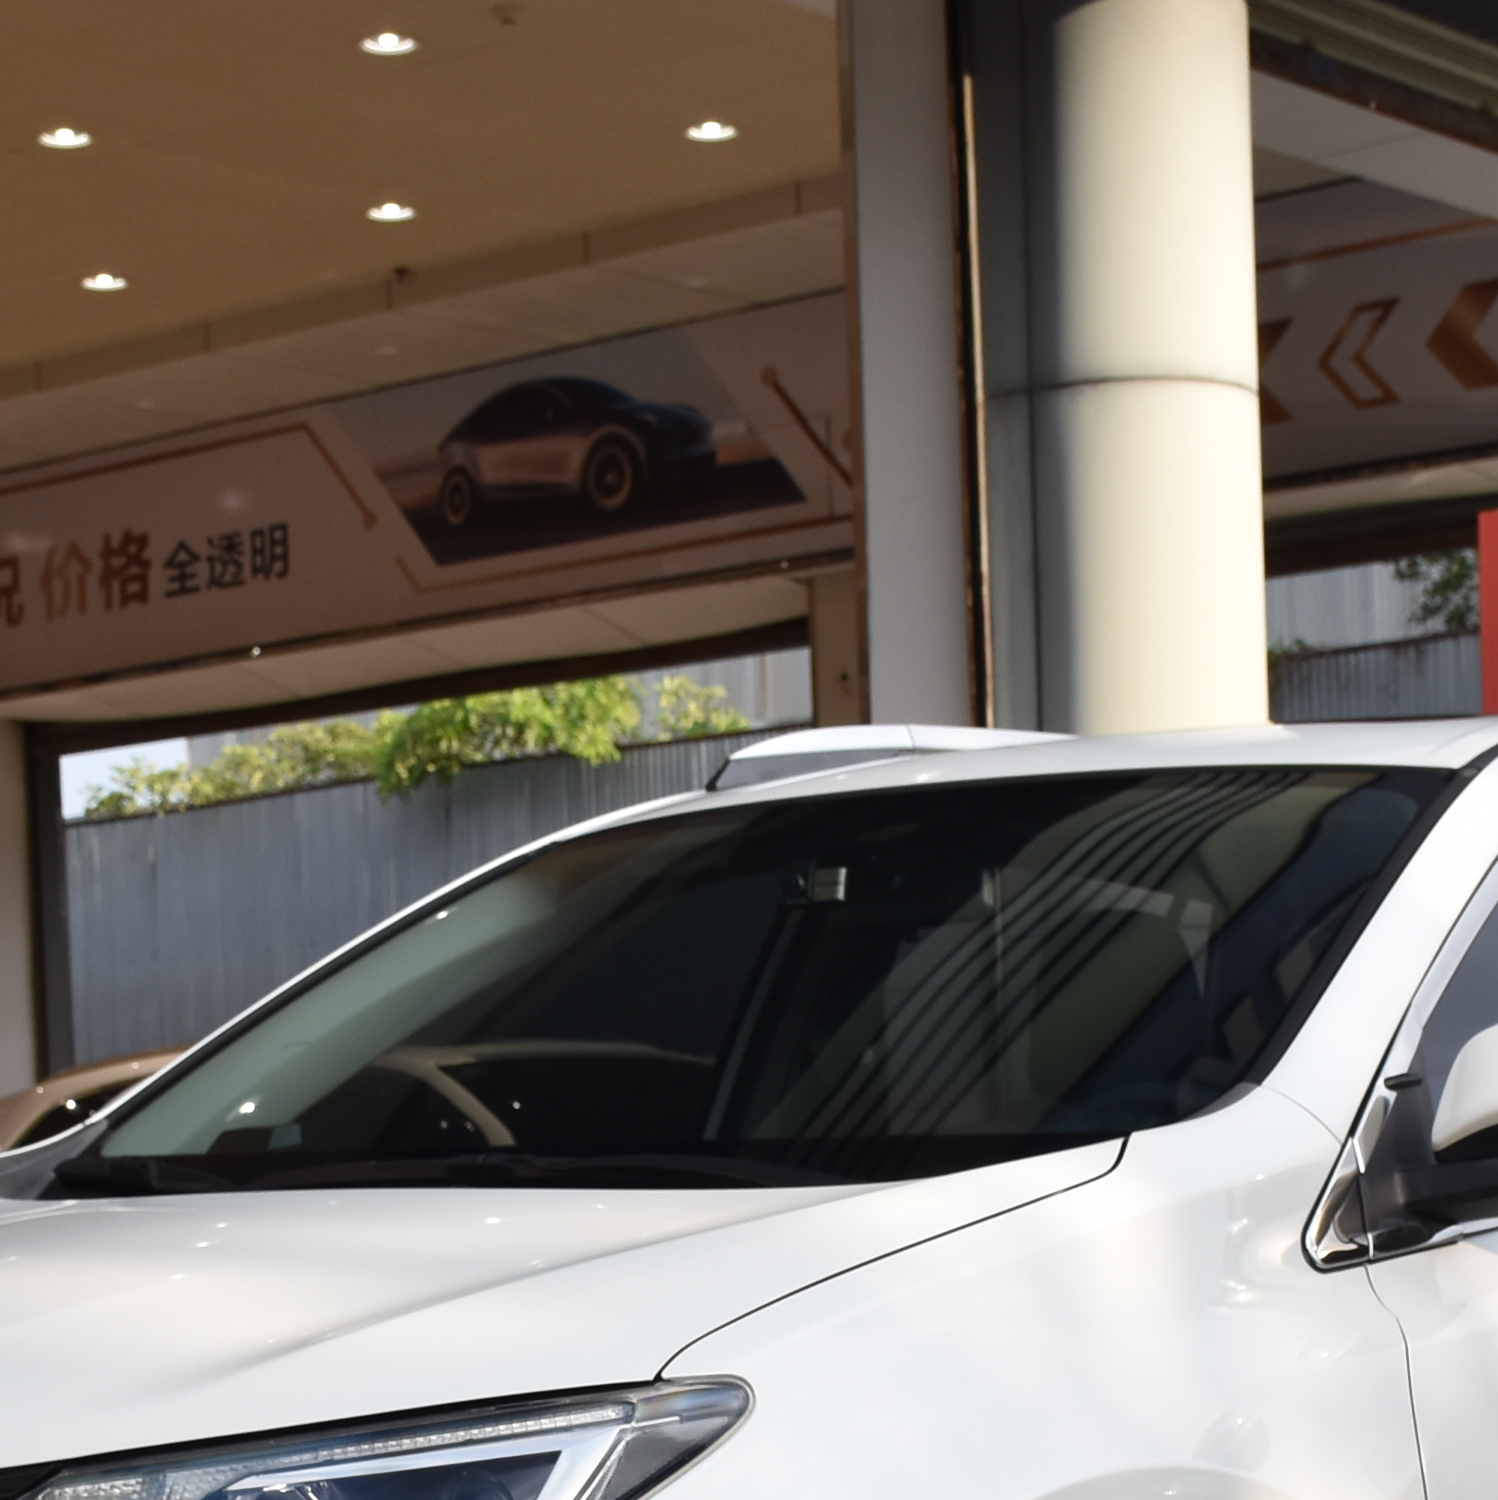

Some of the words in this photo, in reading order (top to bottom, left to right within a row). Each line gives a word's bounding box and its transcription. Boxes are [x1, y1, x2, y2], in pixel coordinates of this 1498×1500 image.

[39, 528, 153, 622] 价格
[162, 522, 290, 599] 全透明
